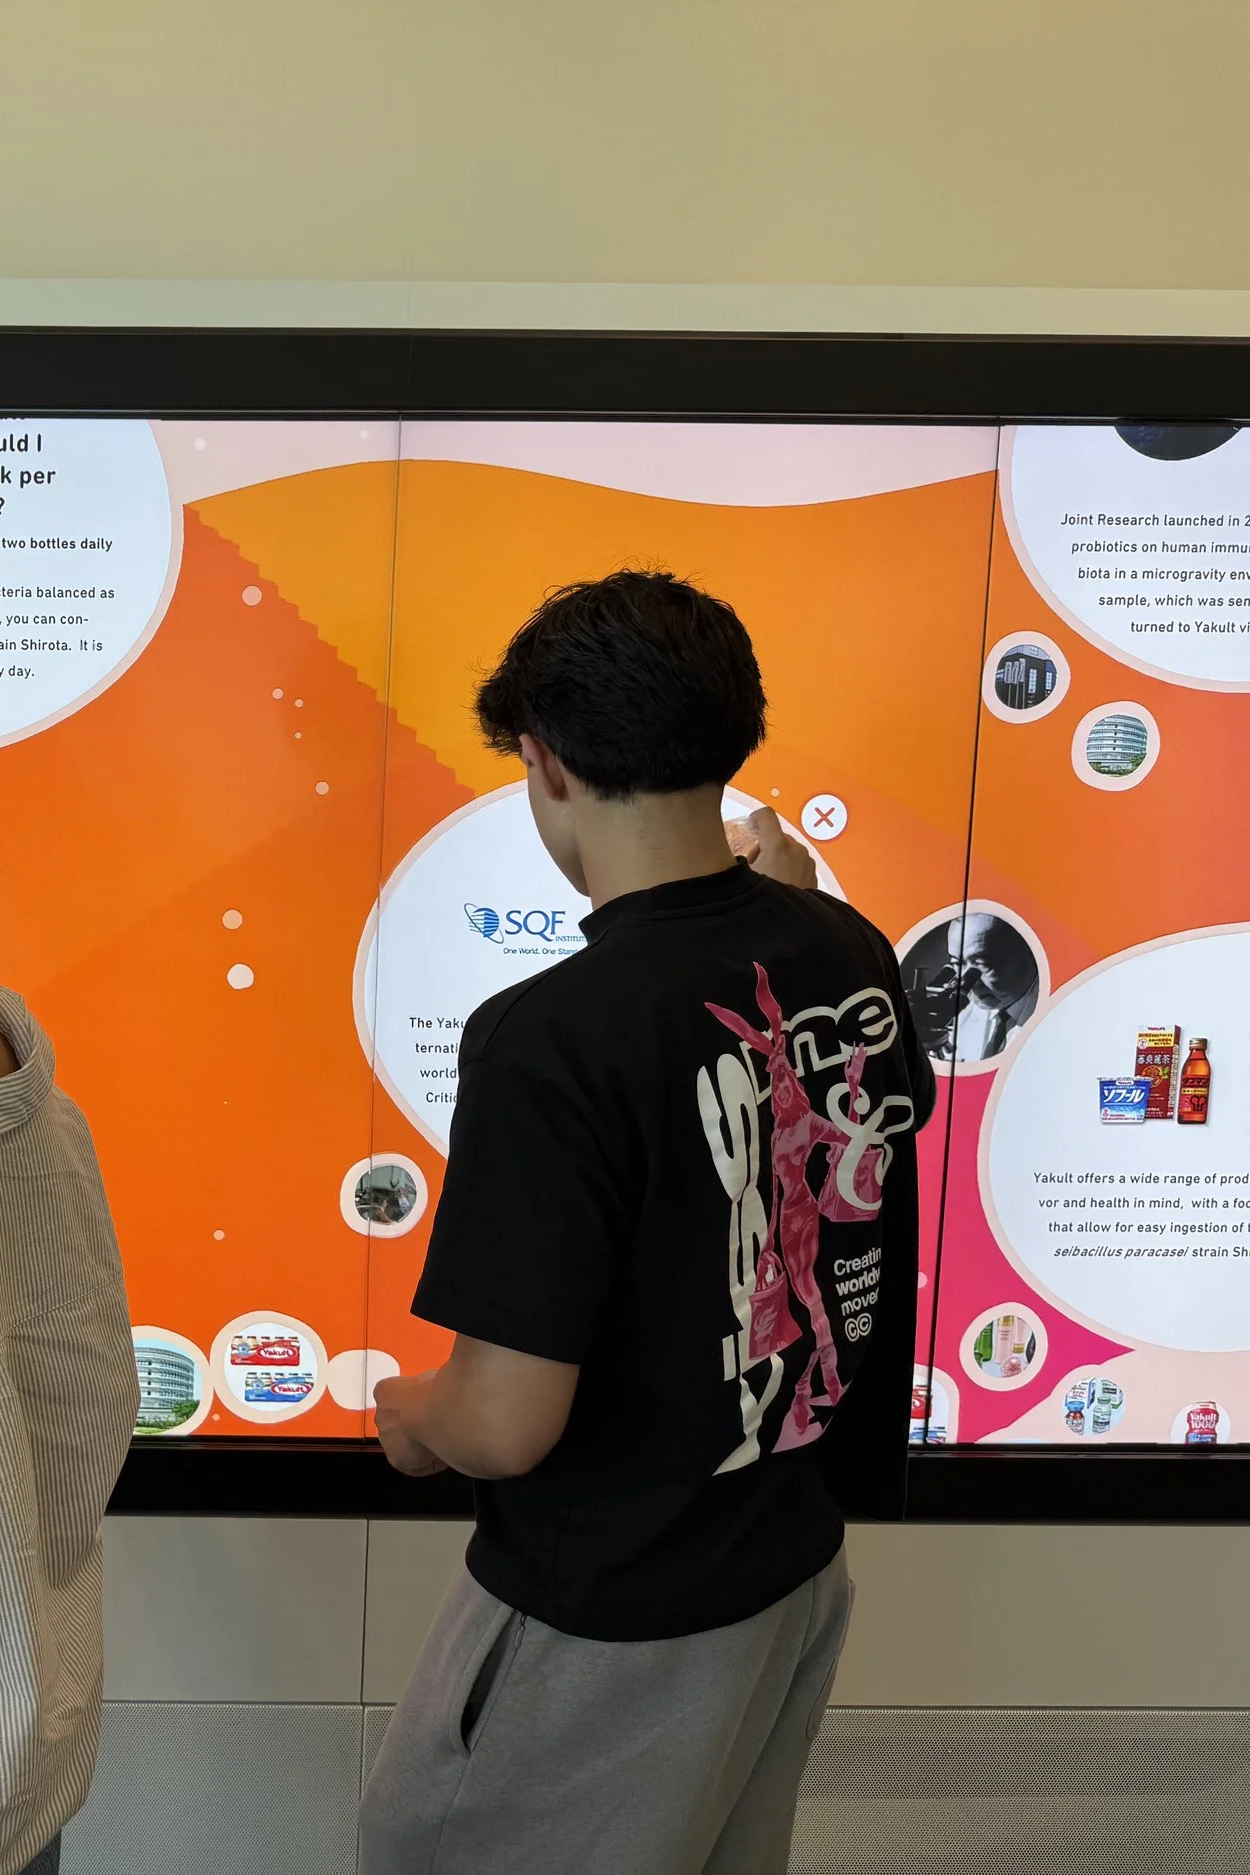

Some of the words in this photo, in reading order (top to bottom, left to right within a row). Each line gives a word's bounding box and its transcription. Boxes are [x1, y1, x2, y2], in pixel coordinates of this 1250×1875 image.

[36, 432, 42, 452] I
[19, 470, 57, 489] per
[1060, 512, 1094, 525] Joint
[1097, 513, 1160, 526] Research
[1163, 513, 1225, 526] launched
[1227, 514, 1241, 526] in
[1, 536, 27, 548] two
[29, 536, 77, 549] bottles
[79, 536, 113, 552] daily
[1071, 539, 1138, 555] probiotics
[1141, 543, 1158, 552] on
[1161, 540, 1207, 553] human
[1077, 566, 1111, 579] biota
[1114, 567, 1127, 579] in
[1129, 569, 1138, 579] a
[1141, 567, 1227, 583] microgravity
[36, 585, 96, 598] balanced
[99, 589, 115, 598] as
[1098, 593, 1151, 608] sample,
[1154, 593, 1194, 606] which
[1197, 597, 1225, 606] was
[5, 614, 29, 627] you
[32, 614, 56, 624] can
[59, 615, 89, 624] con-
[1130, 620, 1175, 632] turned
[1177, 621, 1191, 632] to
[1194, 620, 1236, 633] Yakult
[20, 638, 72, 651] Shirota.
[79, 639, 89, 651] It
[91, 639, 103, 651] is
[7, 664, 36, 682] day.
[504, 910, 566, 942] SQF
[503, 947, 517, 955] One
[541, 947, 556, 955] One
[409, 1016, 433, 1029] The
[419, 1067, 458, 1079] world
[1103, 1088, 1145, 1103] ソフール
[1033, 1171, 1074, 1183] Yakult
[1076, 1171, 1115, 1183] offers
[1118, 1174, 1126, 1183] a
[1129, 1172, 1160, 1184] wide
[1163, 1175, 1201, 1186] range
[1203, 1172, 1218, 1184] of
[1219, 1172, 1250, 1186] prod
[1038, 1199, 1060, 1208] vor
[1062, 1196, 1087, 1208] and
[1089, 1196, 1130, 1208] health
[1133, 1196, 1146, 1208] in
[1148, 1196, 1184, 1210] mind,
[1190, 1197, 1219, 1208] with
[1221, 1199, 1230, 1208] a
[1048, 1220, 1074, 1232] that
[1076, 1220, 1112, 1232] allow
[1114, 1221, 1134, 1232] for
[1136, 1223, 1167, 1235] easy
[1169, 1221, 1228, 1235] ingestion
[1231, 1221, 1245, 1233] of
[1053, 1244, 1123, 1258] seibacillus
[1124, 1245, 1190, 1261] paracasei
[1191, 1246, 1229, 1258] strain
[262, 1348, 291, 1357] Yakult
[277, 1385, 306, 1393] Yakult
[1190, 1412, 1217, 1421] Yakult
